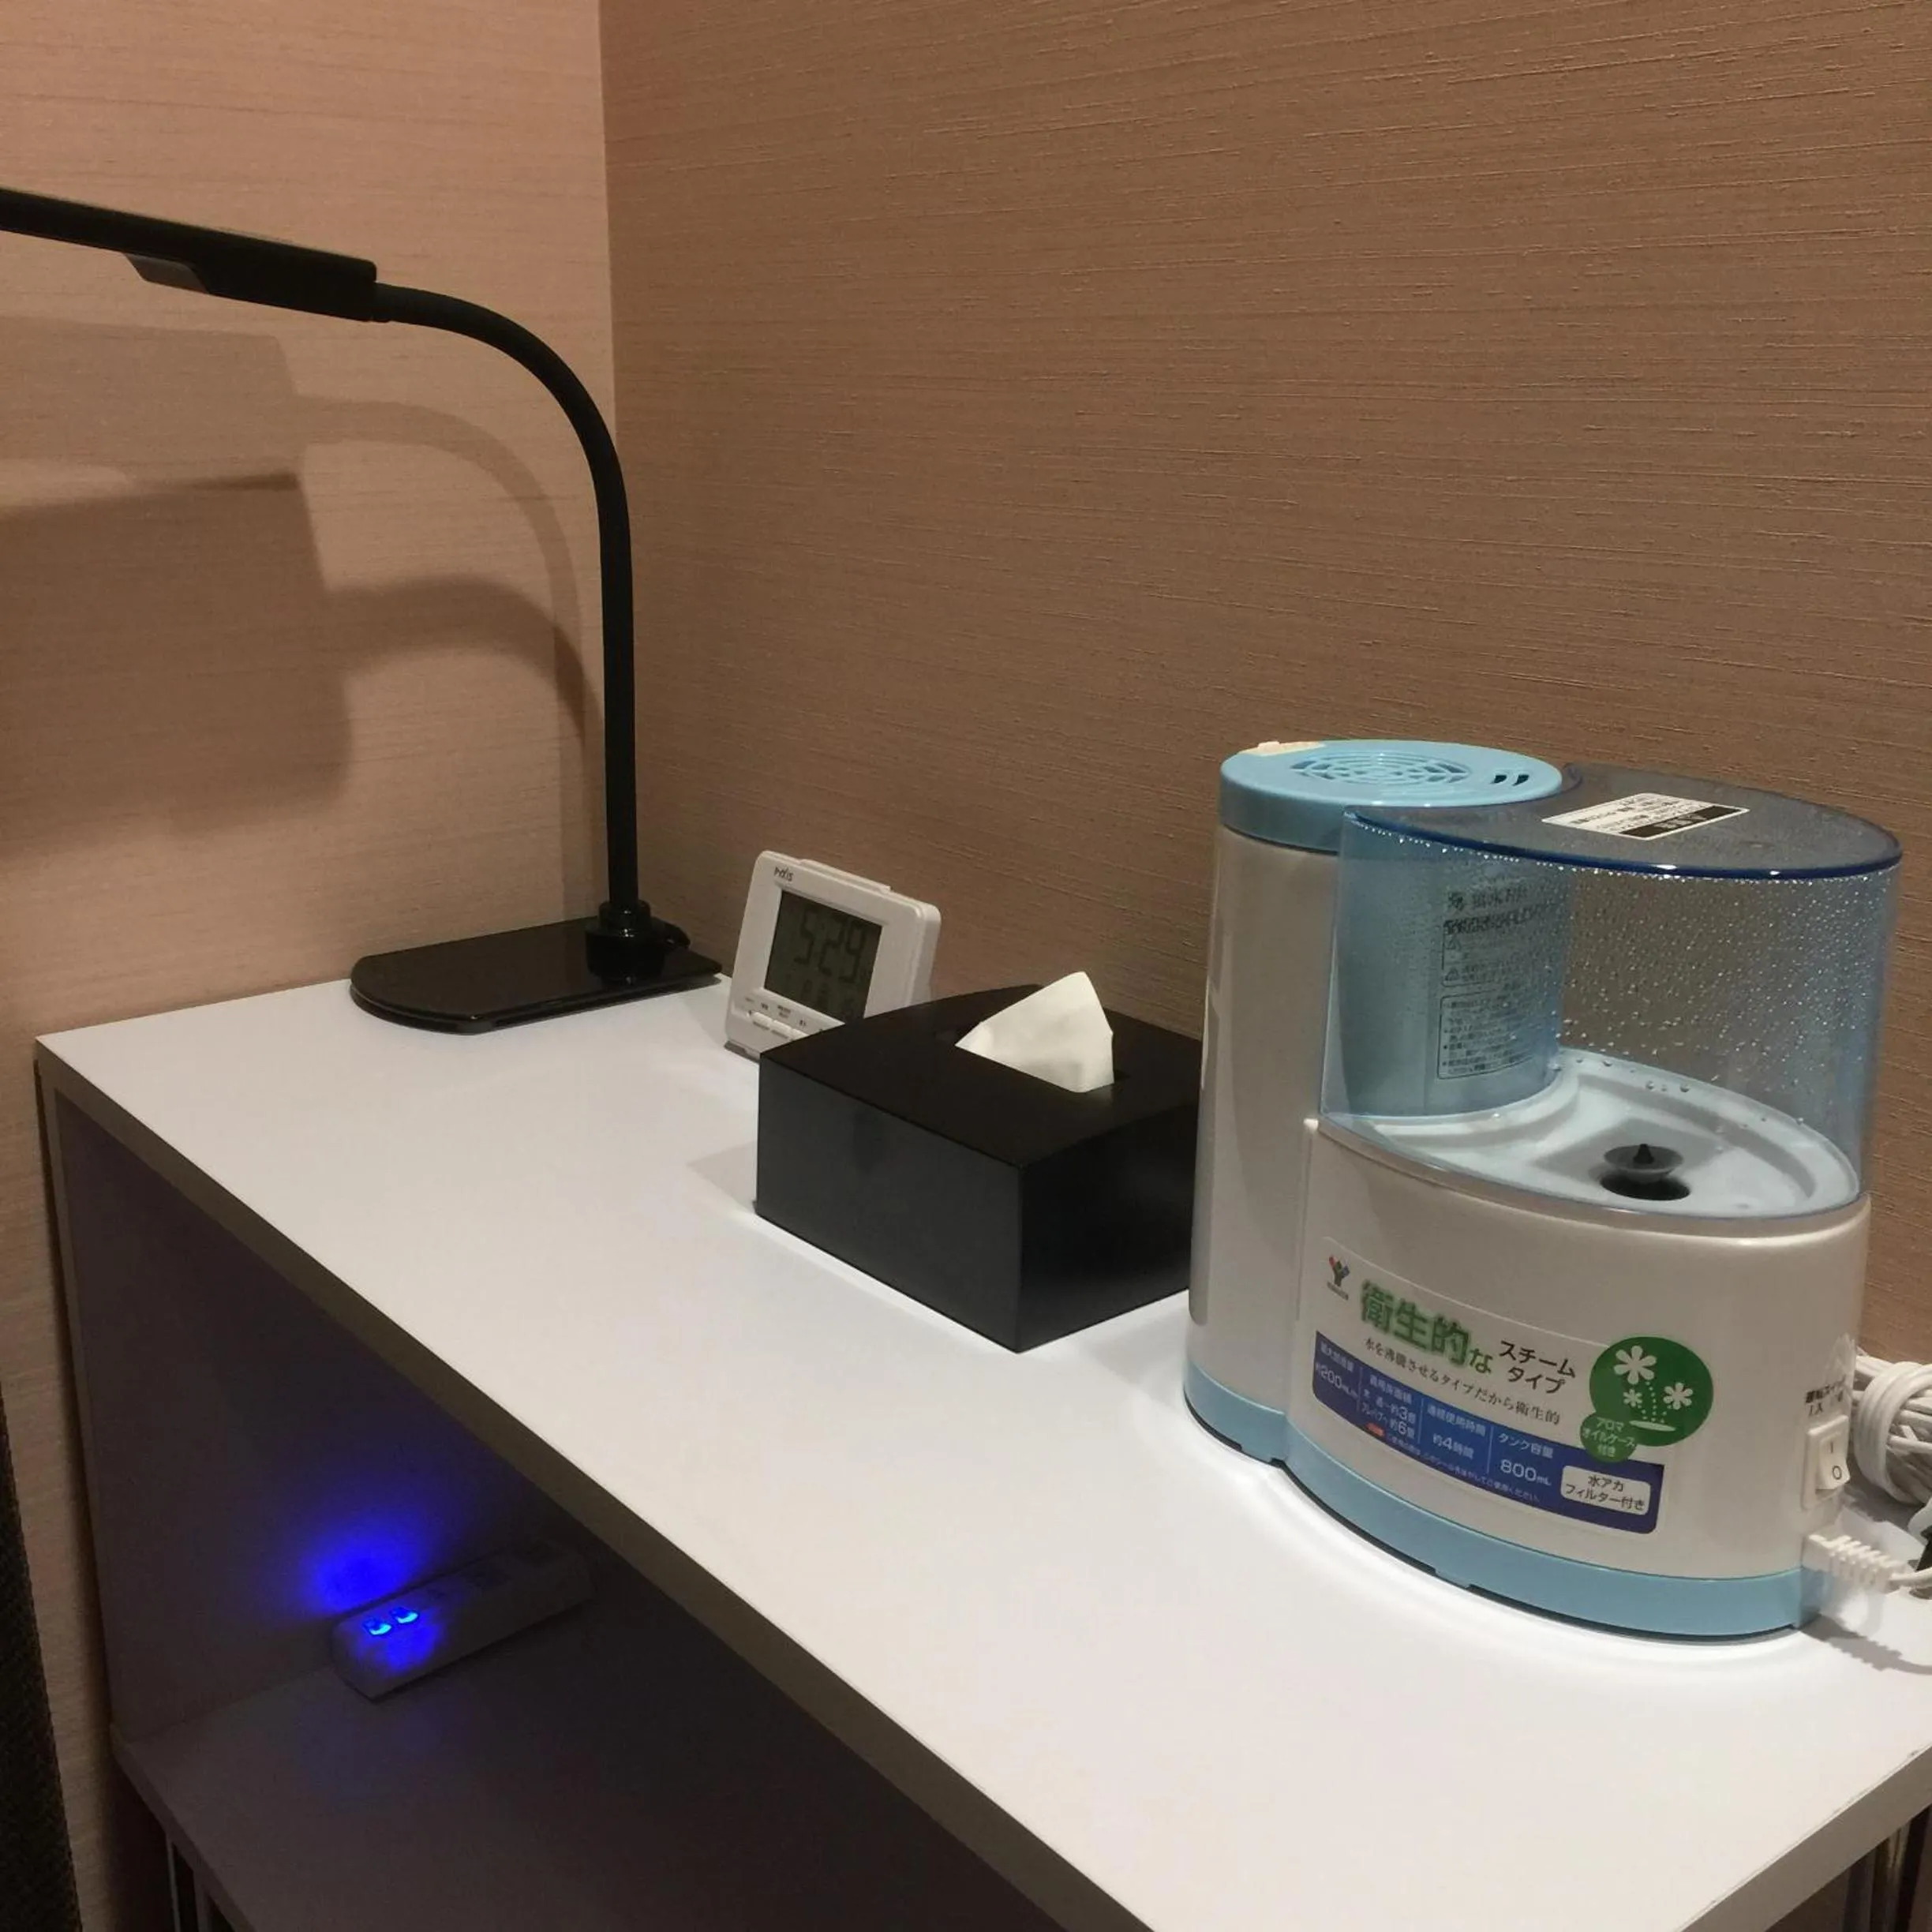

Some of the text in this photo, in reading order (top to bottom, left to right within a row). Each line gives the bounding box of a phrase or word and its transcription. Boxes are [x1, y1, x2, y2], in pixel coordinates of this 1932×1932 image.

[1361, 1279, 1493, 1374] 衛生的な
[1500, 1340, 1576, 1378] スチーム
[1507, 1367, 1566, 1394] タイプ
[1499, 1432, 1554, 1459] タンク容量
[1597, 1443, 1616, 1458] 付き
[1587, 1474, 1624, 1492] 水アカ
[1566, 1483, 1646, 1511] フィルター付き
